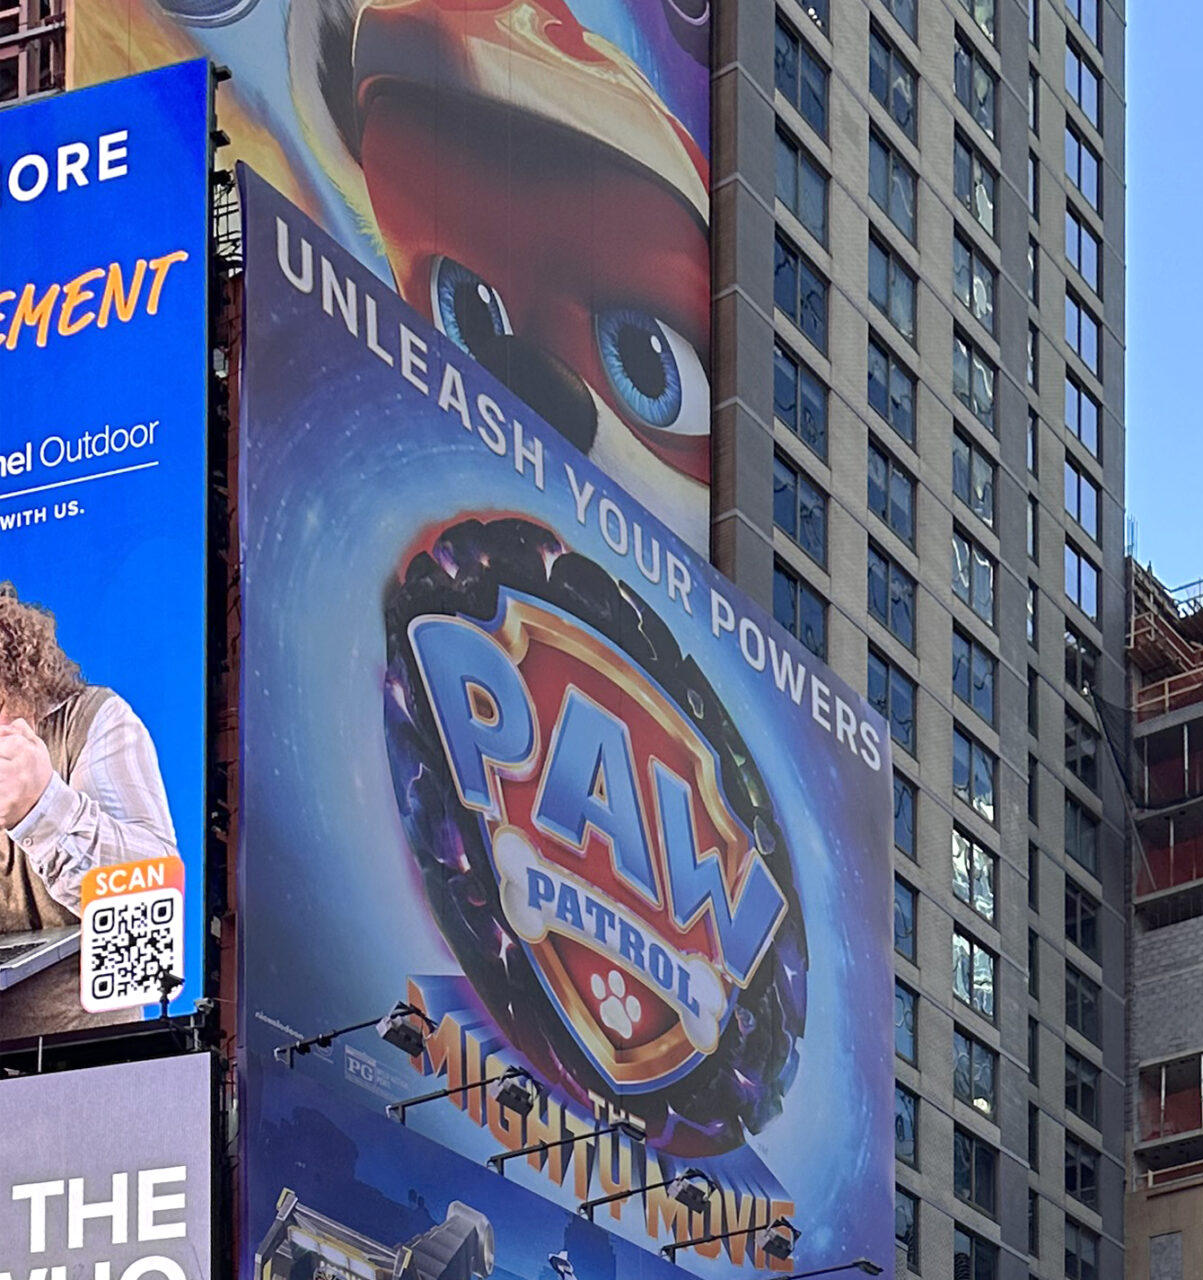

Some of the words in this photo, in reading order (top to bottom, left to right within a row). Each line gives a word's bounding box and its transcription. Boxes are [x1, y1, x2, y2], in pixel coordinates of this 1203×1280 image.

[9, 130, 129, 202] ORE
[40, 420, 160, 468] Outdoor
[0, 508, 46, 530] WITH
[54, 500, 85, 519] US.
[276, 215, 546, 490] UNLEASH
[564, 465, 695, 615] YOUR
[711, 591, 883, 771] POWERS
[407, 613, 790, 990] PAW
[96, 863, 165, 895] SCAN
[526, 868, 700, 1017] PATROL
[347, 1057, 375, 1083] PG
[407, 979, 636, 1220] MIGHTY
[12, 1165, 187, 1253] THE
